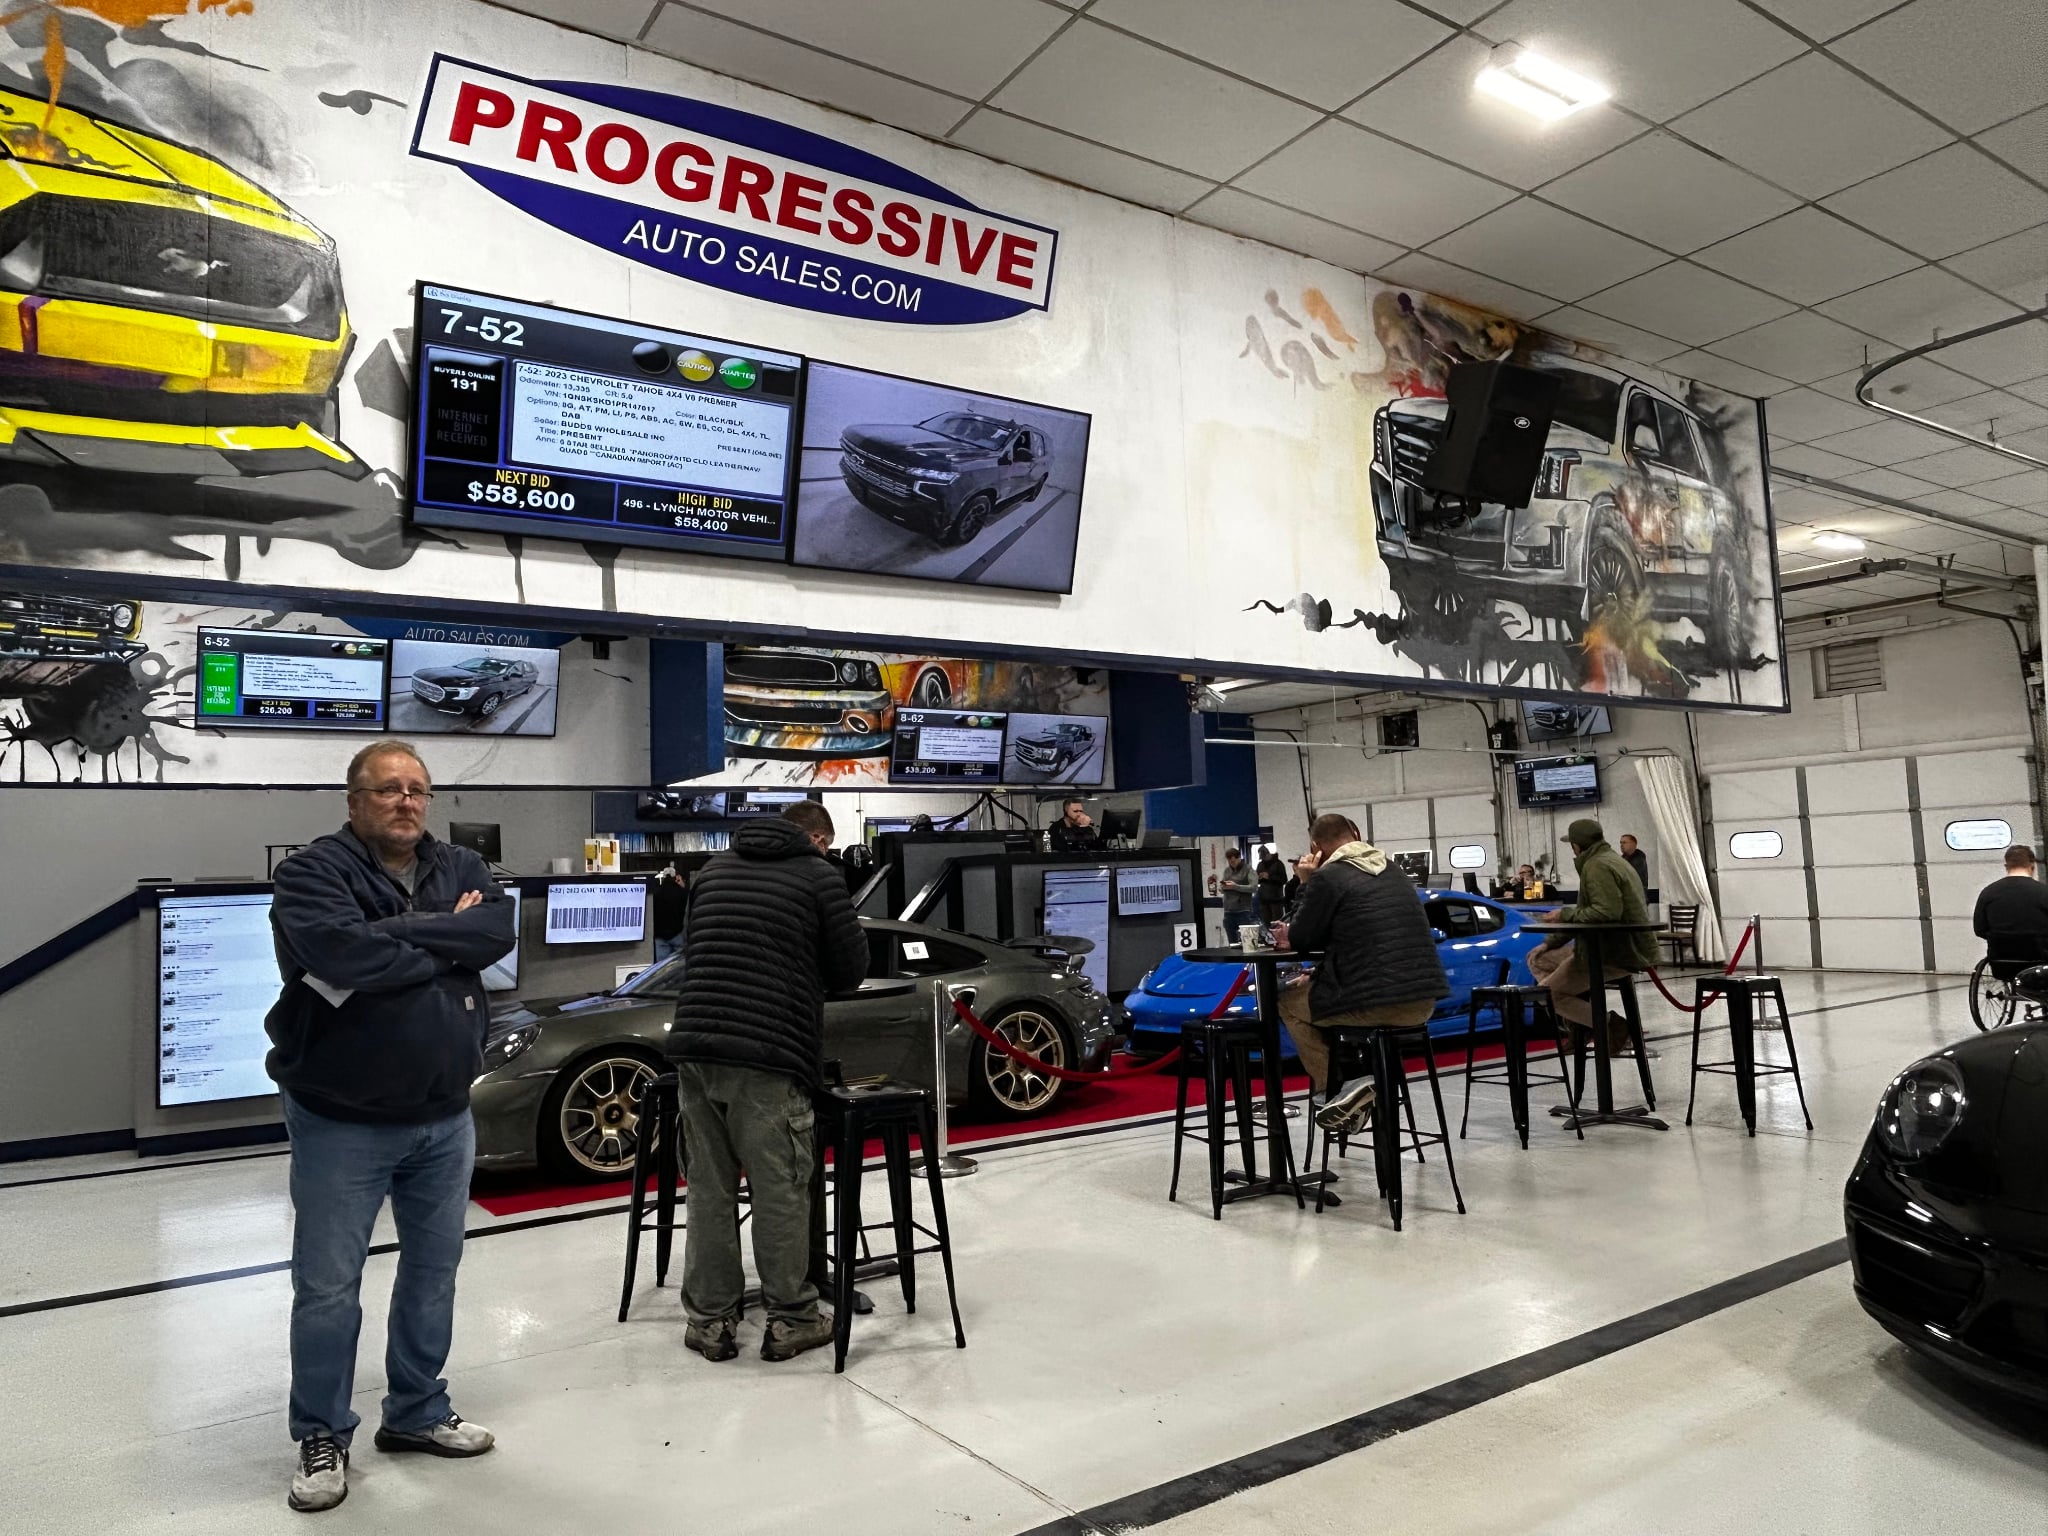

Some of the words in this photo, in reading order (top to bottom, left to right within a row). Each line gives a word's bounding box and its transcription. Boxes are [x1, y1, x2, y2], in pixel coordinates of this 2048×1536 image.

[448, 81, 1037, 289] PROGRESSIVE
[622, 219, 726, 265] AUTO
[735, 246, 922, 312] SALES.COM
[440, 308, 525, 347] 7-52
[434, 366, 466, 377] BUYERS
[468, 371, 496, 382] ONLINE
[677, 360, 712, 372] CAUTION
[450, 378, 478, 392] 191
[519, 376, 561, 388] Odometer:
[519, 365, 542, 376] 7-52:
[545, 369, 568, 380] 2023
[570, 374, 630, 390] CHEVROLET
[632, 384, 663, 396] TAHOE
[666, 390, 682, 399] 4X4
[698, 395, 737, 408] PREMIER
[526, 396, 560, 408] Options:
[579, 405, 593, 413] AT,
[544, 389, 561, 398] VIN:
[698, 414, 744, 427] BLACK/BLK
[437, 407, 489, 425] INTERNET
[453, 421, 472, 433] BID
[560, 429, 603, 441] PRESENT
[594, 424, 649, 440] WHOLESALE
[437, 429, 488, 446] RECEIVED
[590, 442, 626, 454] SELLERS
[495, 469, 528, 486] NEXT
[530, 473, 551, 488] BID
[467, 481, 576, 512] $58,600
[678, 492, 706, 508] HIGH
[713, 497, 733, 510] BID
[653, 501, 695, 515] LYNCH
[697, 507, 740, 520] MOTOR
[674, 516, 729, 532] $58,400
[204, 636, 231, 647] 6-52
[404, 627, 446, 641] AUTO
[449, 630, 530, 647] SALESCOM
[900, 713, 924, 723] 8-62
[1180, 928, 1193, 948] 8
